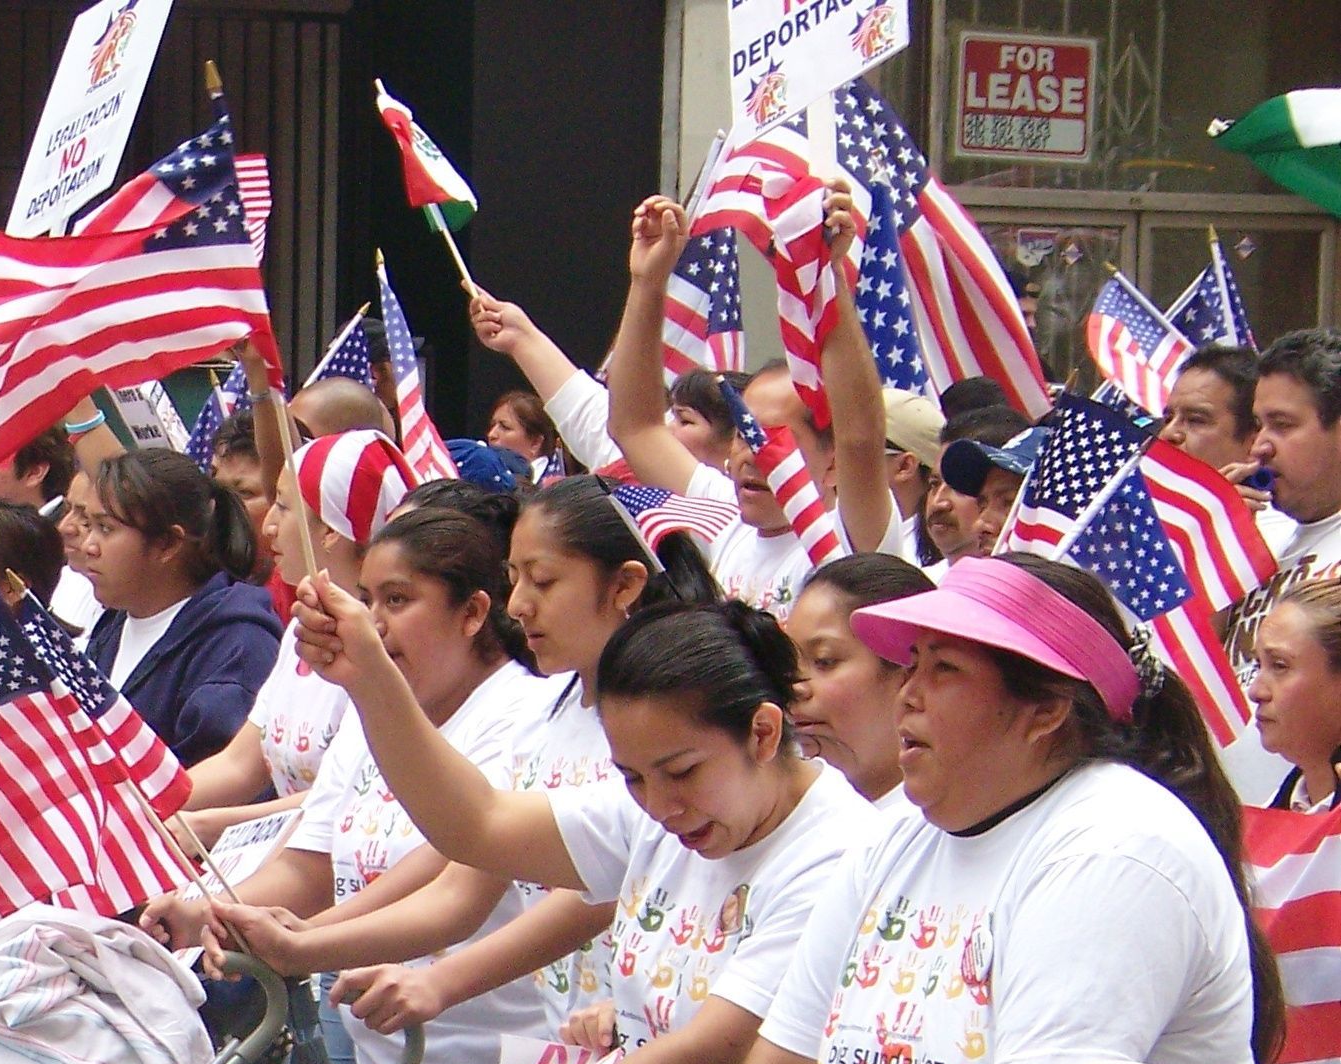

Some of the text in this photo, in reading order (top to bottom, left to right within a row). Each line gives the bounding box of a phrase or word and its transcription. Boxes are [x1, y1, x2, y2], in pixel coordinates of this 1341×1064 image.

[999, 45, 1055, 72] FOR
[966, 72, 1086, 114] LEASE
[59, 136, 87, 178] NO
